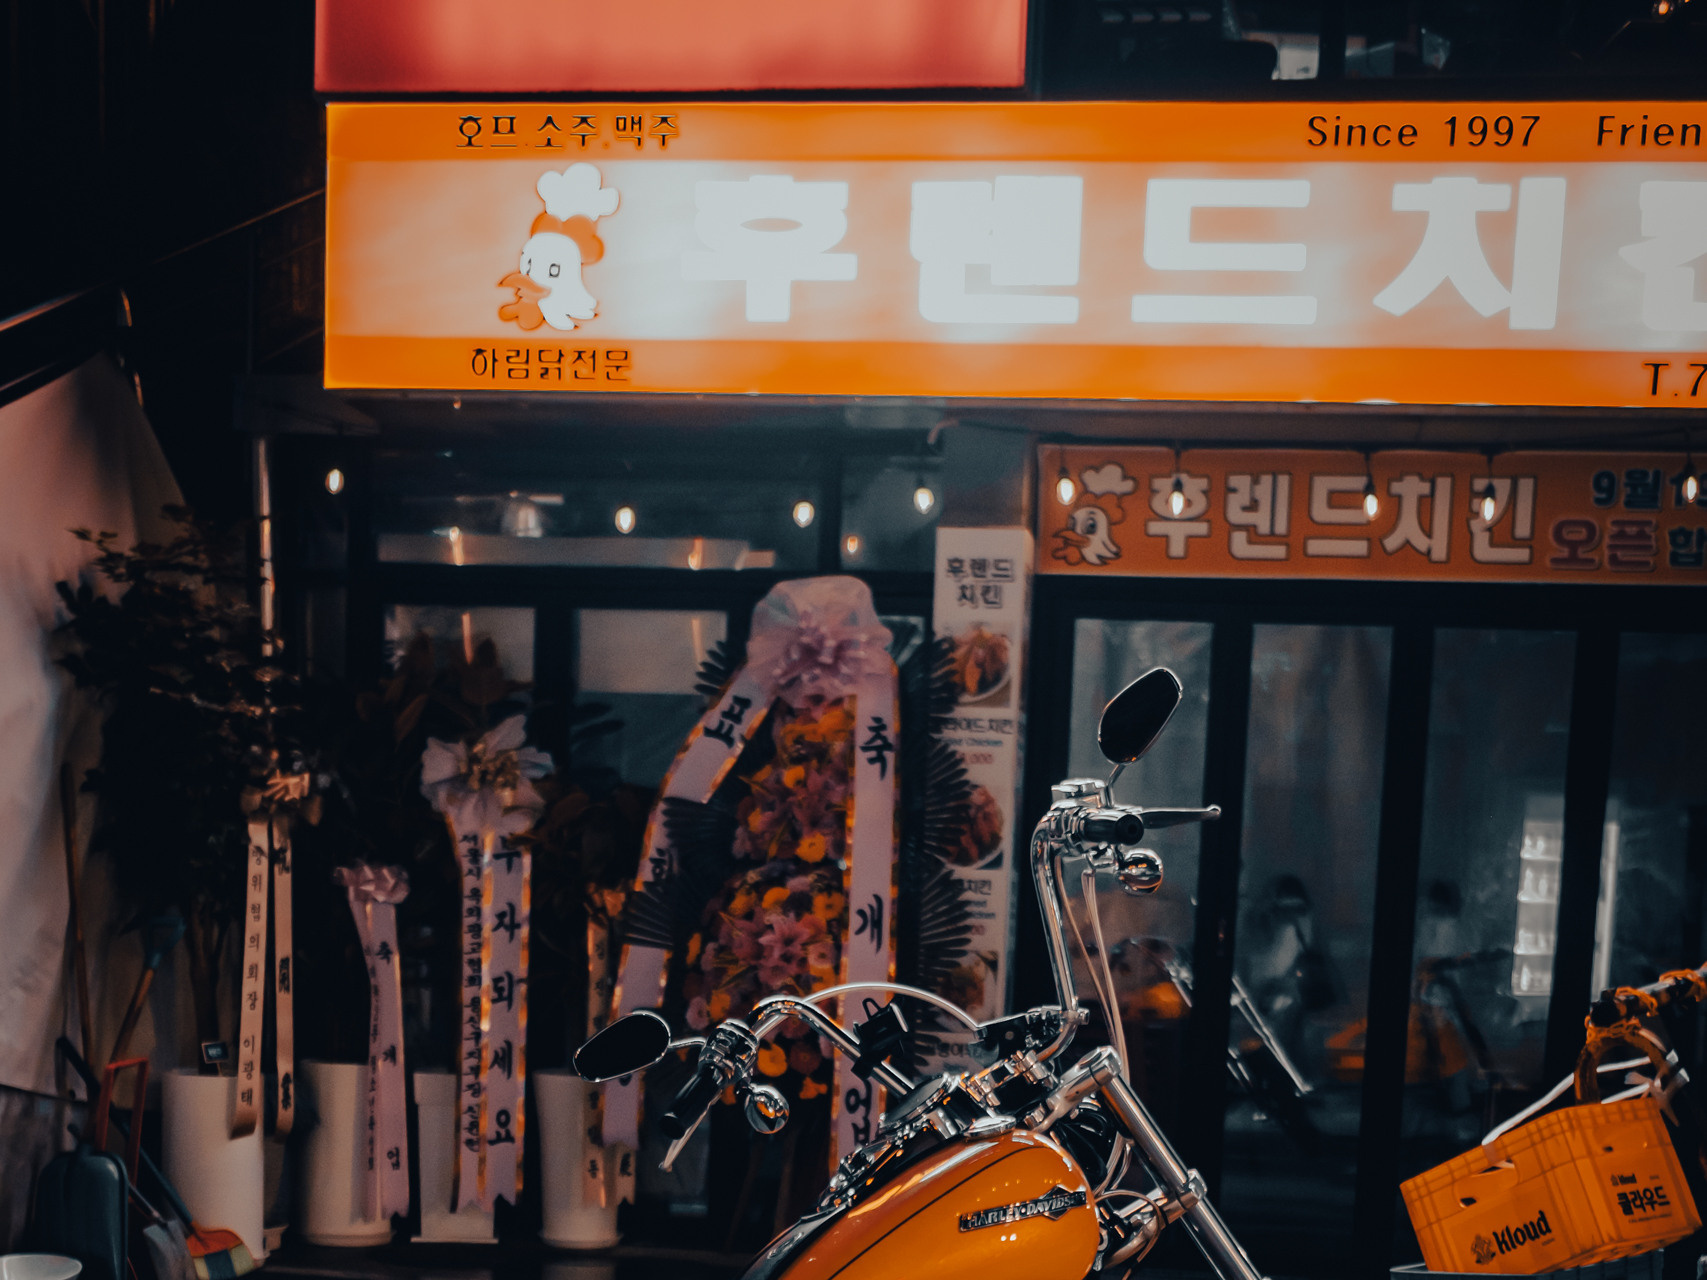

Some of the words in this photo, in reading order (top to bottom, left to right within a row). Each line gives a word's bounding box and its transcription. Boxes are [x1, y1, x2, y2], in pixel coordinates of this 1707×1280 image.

[1307, 114, 1419, 147] Since
[1444, 114, 1541, 147] 1997
[1592, 468, 1662, 510] 9월
[1145, 472, 1538, 566] 후렌드치킨
[1549, 518, 1656, 572] 오픈
[957, 584, 1002, 608] 치킨
[1616, 1185, 1671, 1216] 클라우드
